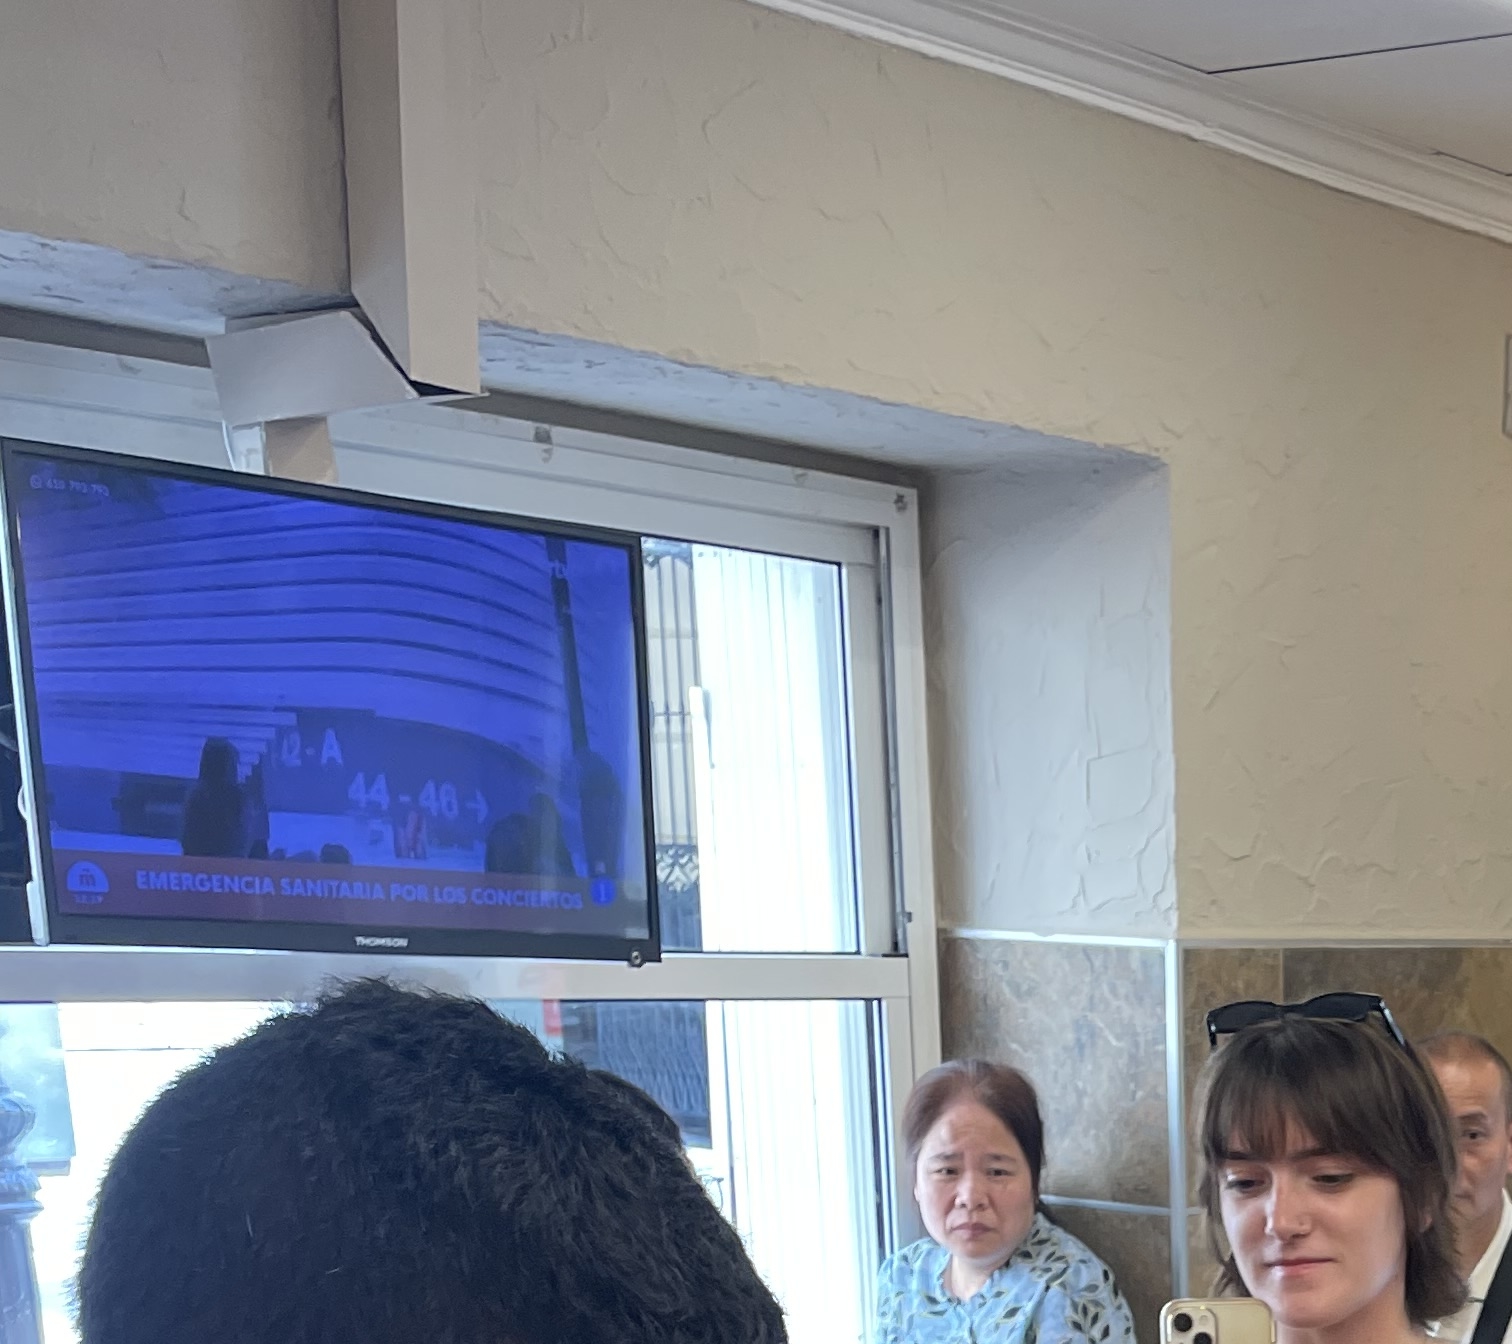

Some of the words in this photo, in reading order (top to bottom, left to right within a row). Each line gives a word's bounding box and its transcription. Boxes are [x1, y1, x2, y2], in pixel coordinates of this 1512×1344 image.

[135, 870, 275, 896] EMERGENCIA
[281, 877, 386, 900] SANITARIA
[390, 883, 428, 901] POR
[433, 886, 466, 904] LOS
[471, 888, 584, 910] CONCIERTOS
